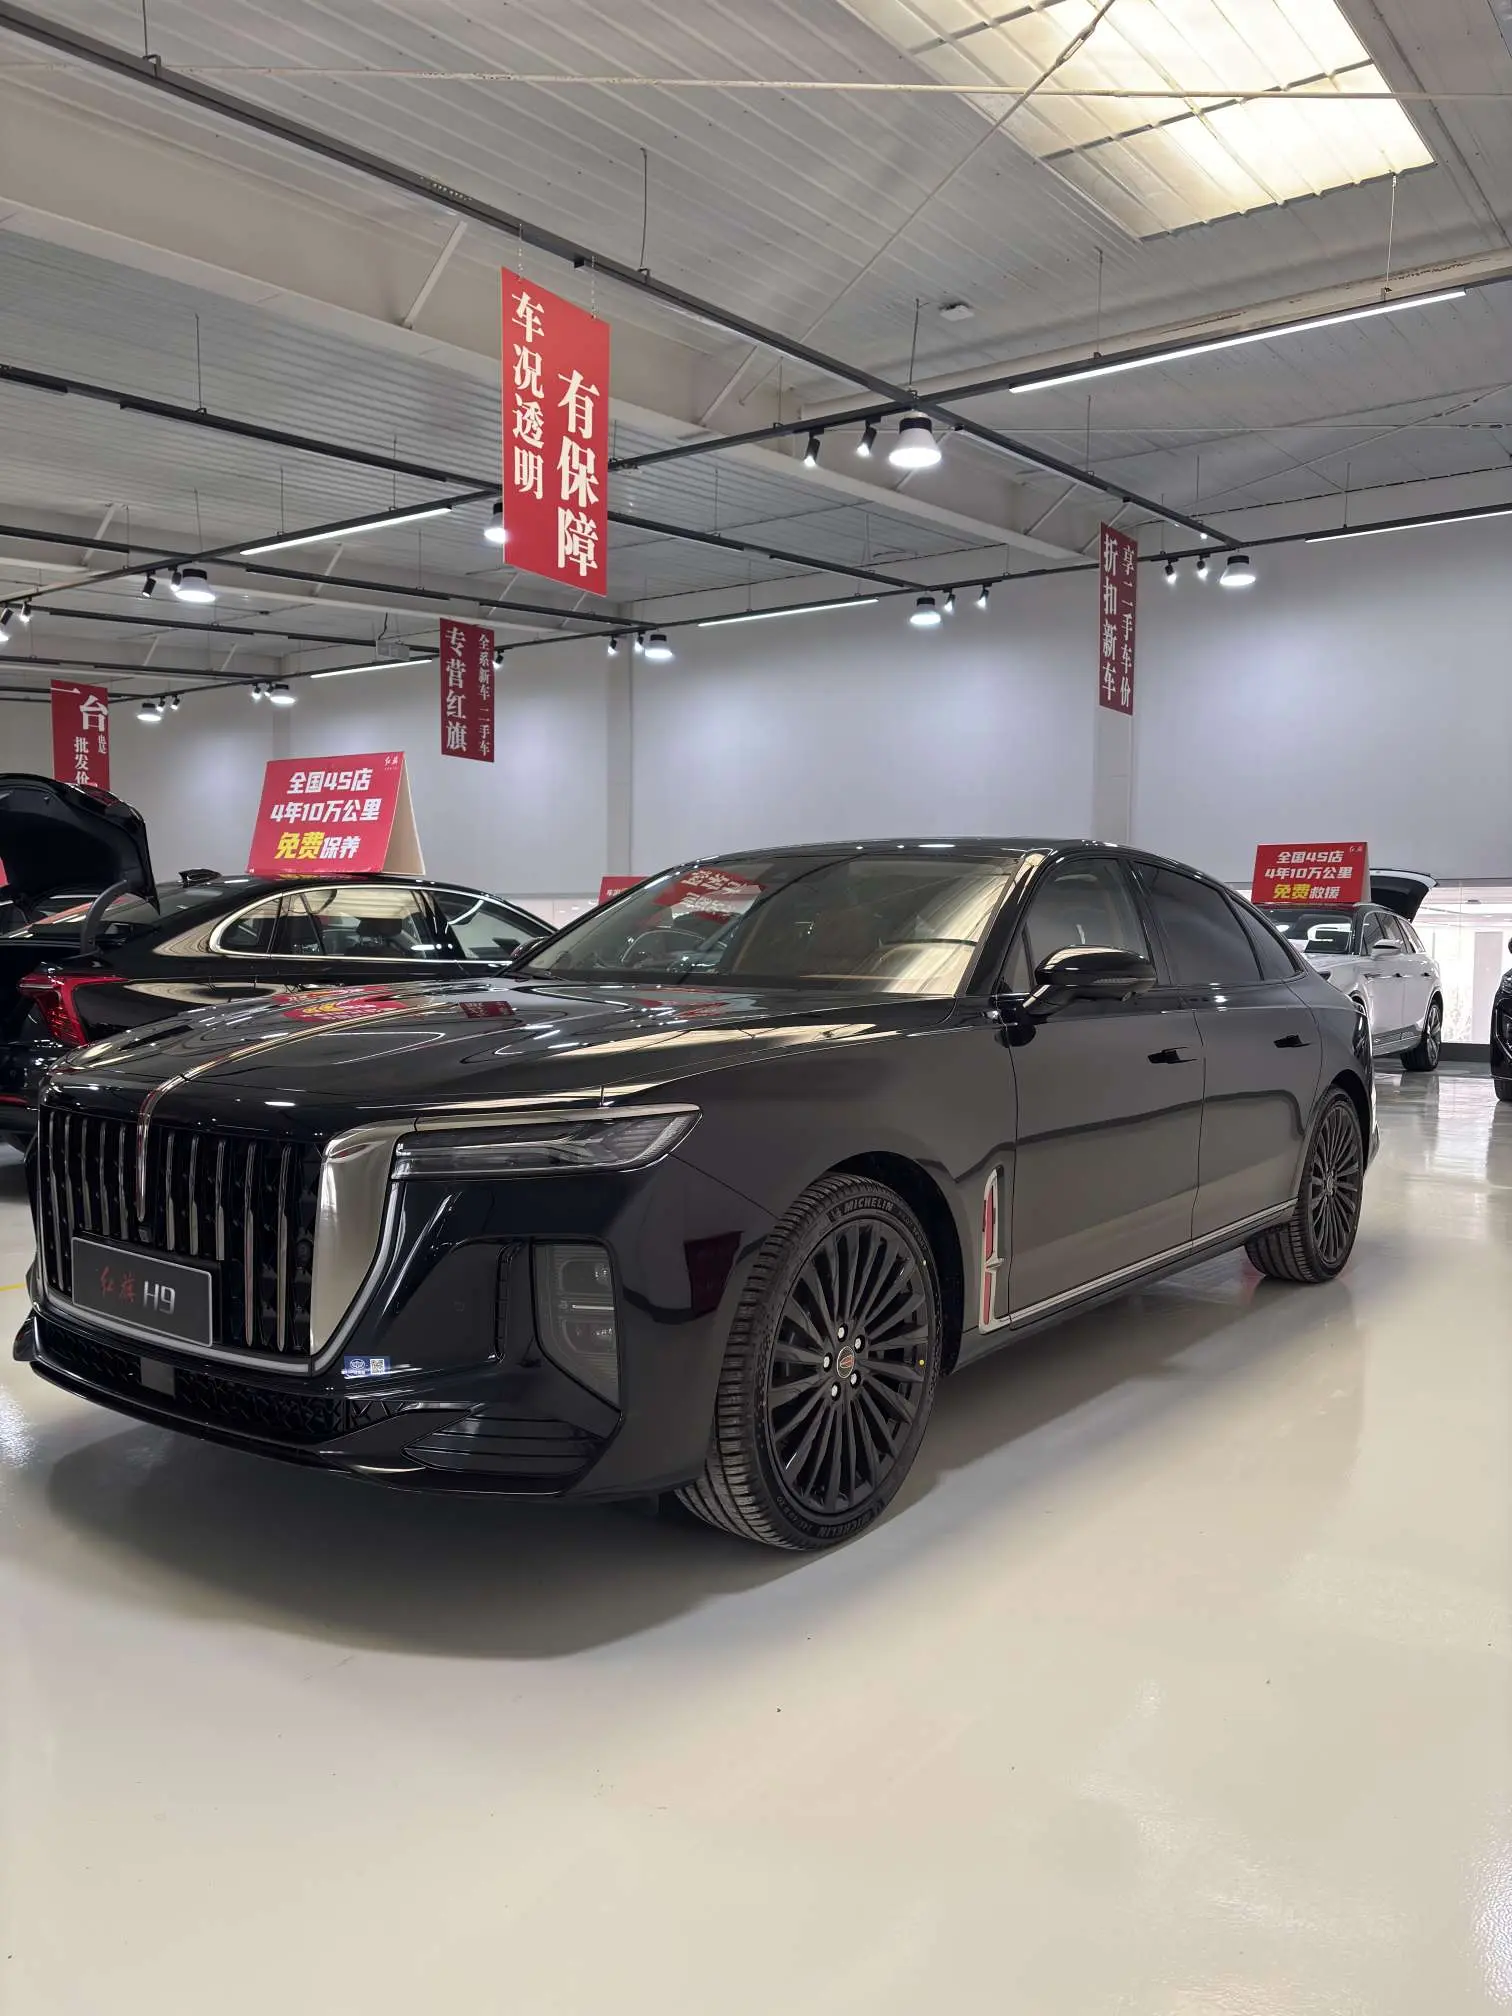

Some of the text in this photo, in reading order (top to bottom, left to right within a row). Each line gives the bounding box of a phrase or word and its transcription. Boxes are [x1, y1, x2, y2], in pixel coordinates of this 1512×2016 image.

[512, 292, 545, 500] 车况透明
[557, 369, 600, 577] 有保障
[1103, 532, 1118, 701] 折扣新车
[445, 626, 467, 752] 专营红旗
[478, 634, 491, 757] 全系新车 二手车
[74, 736, 90, 785] 批发价
[287, 767, 373, 794] 全国4S店
[270, 798, 382, 824] 4年10万公里
[274, 831, 361, 860] 免费保养
[1276, 850, 1345, 864] 全国4S店
[1264, 866, 1353, 880] 4年10万公里
[1273, 883, 1341, 900] 免费救援
[843, 1198, 894, 1213] MICHELIN
[143, 1280, 176, 1315] H9
